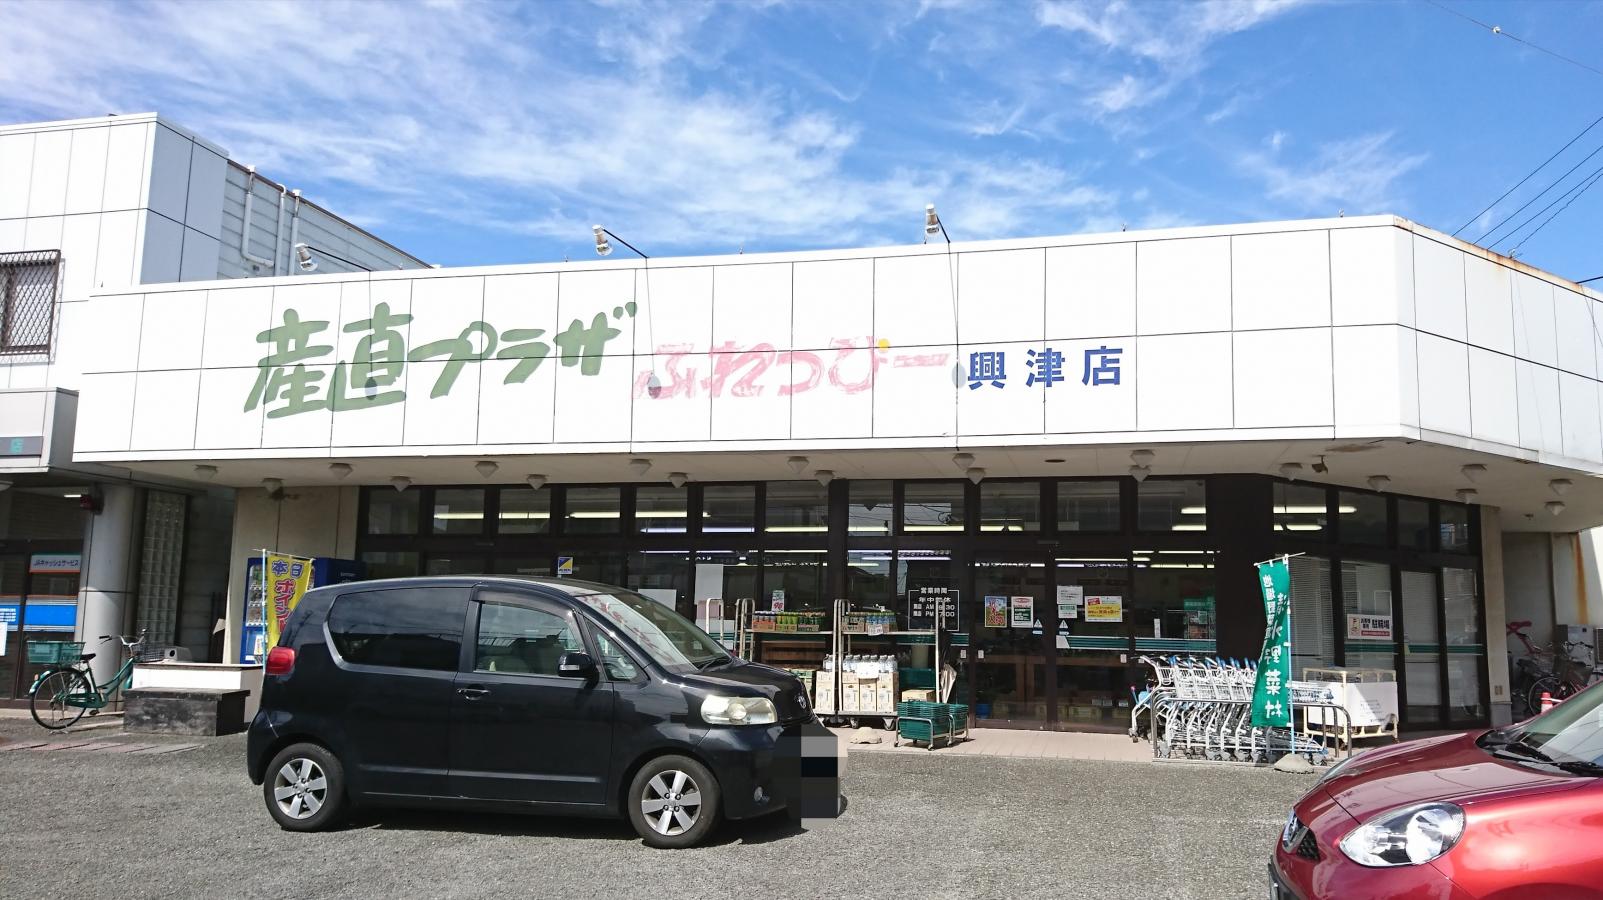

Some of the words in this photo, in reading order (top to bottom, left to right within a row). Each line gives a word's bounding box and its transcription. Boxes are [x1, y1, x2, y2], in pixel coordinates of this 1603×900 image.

[244, 302, 638, 419] 産直プラザ
[967, 345, 1123, 389] 興津店
[272, 560, 304, 579] 本日
